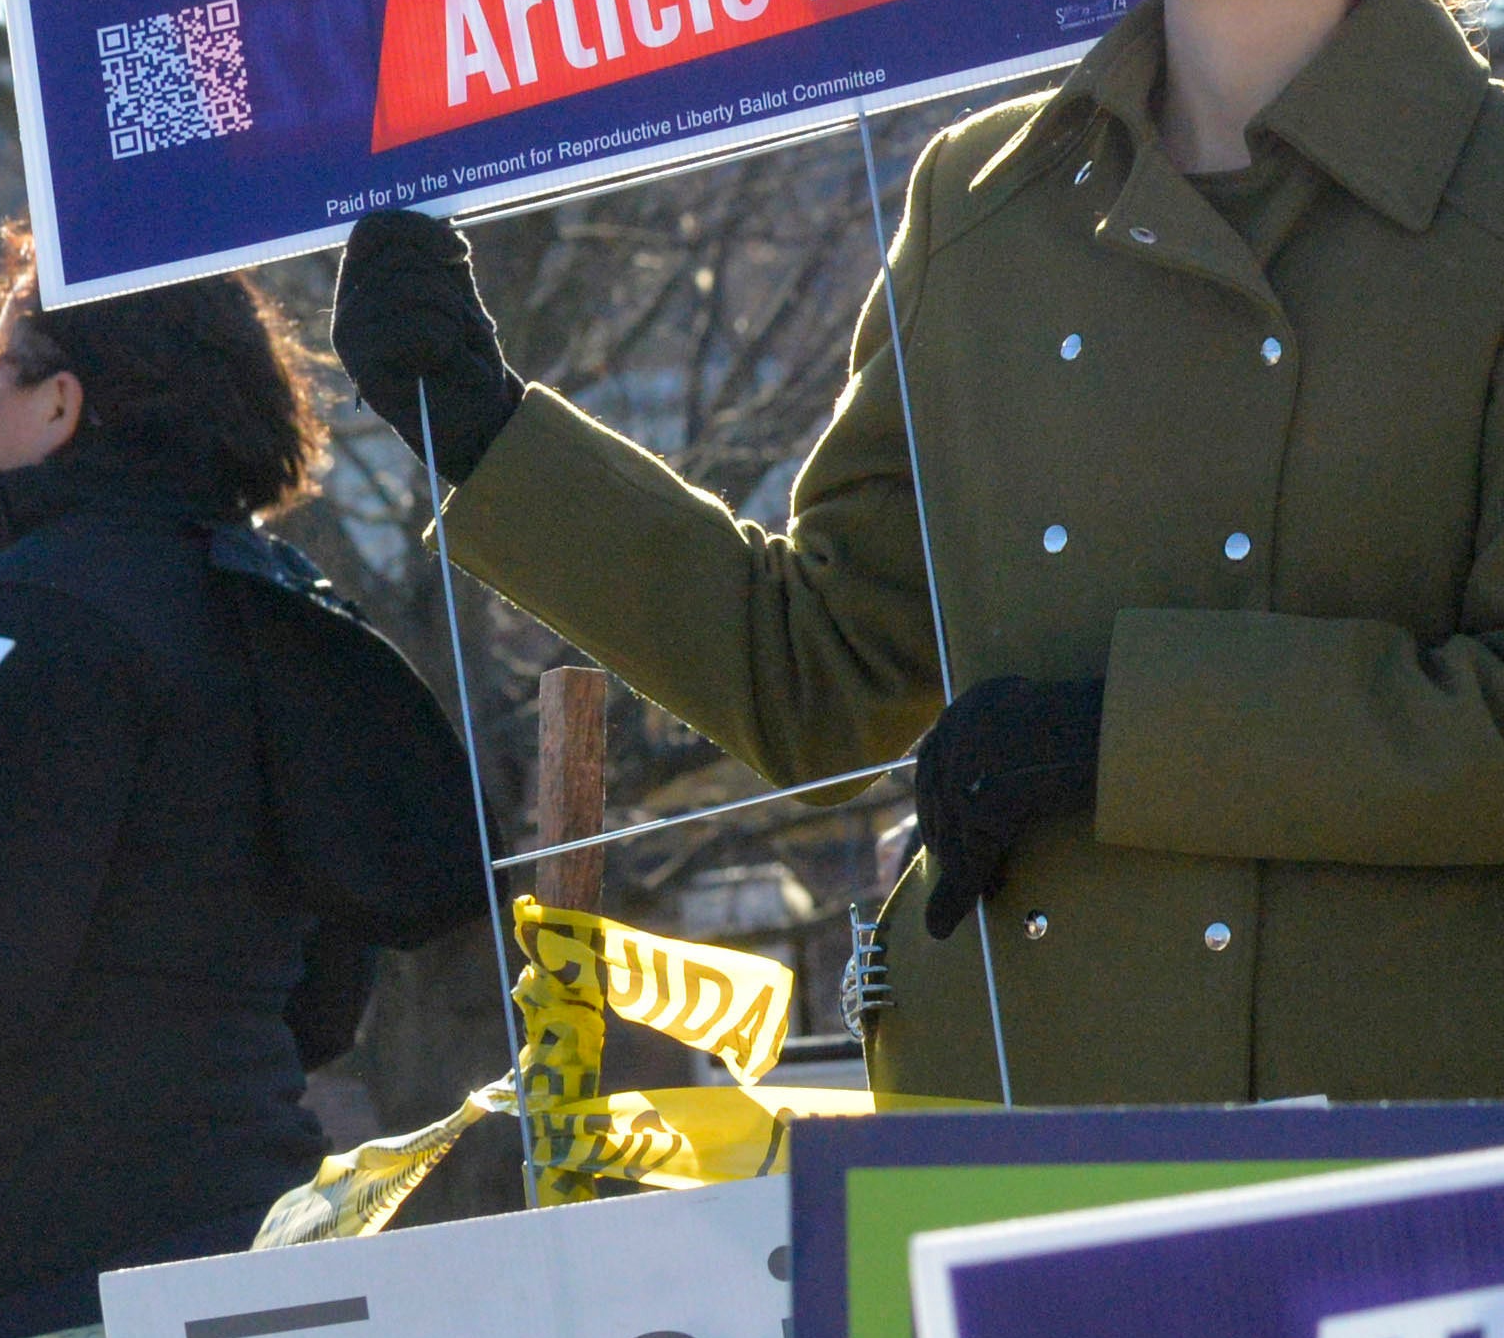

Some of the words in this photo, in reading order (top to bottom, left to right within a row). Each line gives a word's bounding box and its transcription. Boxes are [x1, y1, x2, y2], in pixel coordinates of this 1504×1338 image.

[326, 192, 365, 218] Paid
[369, 186, 394, 209] for
[396, 178, 417, 205] by
[421, 173, 448, 194] the
[453, 155, 526, 186] Vermont
[529, 145, 554, 167] for
[558, 118, 671, 162] Reproductive
[676, 103, 735, 134] Liberty
[739, 88, 788, 117] Ballot
[792, 68, 887, 104] Committee
